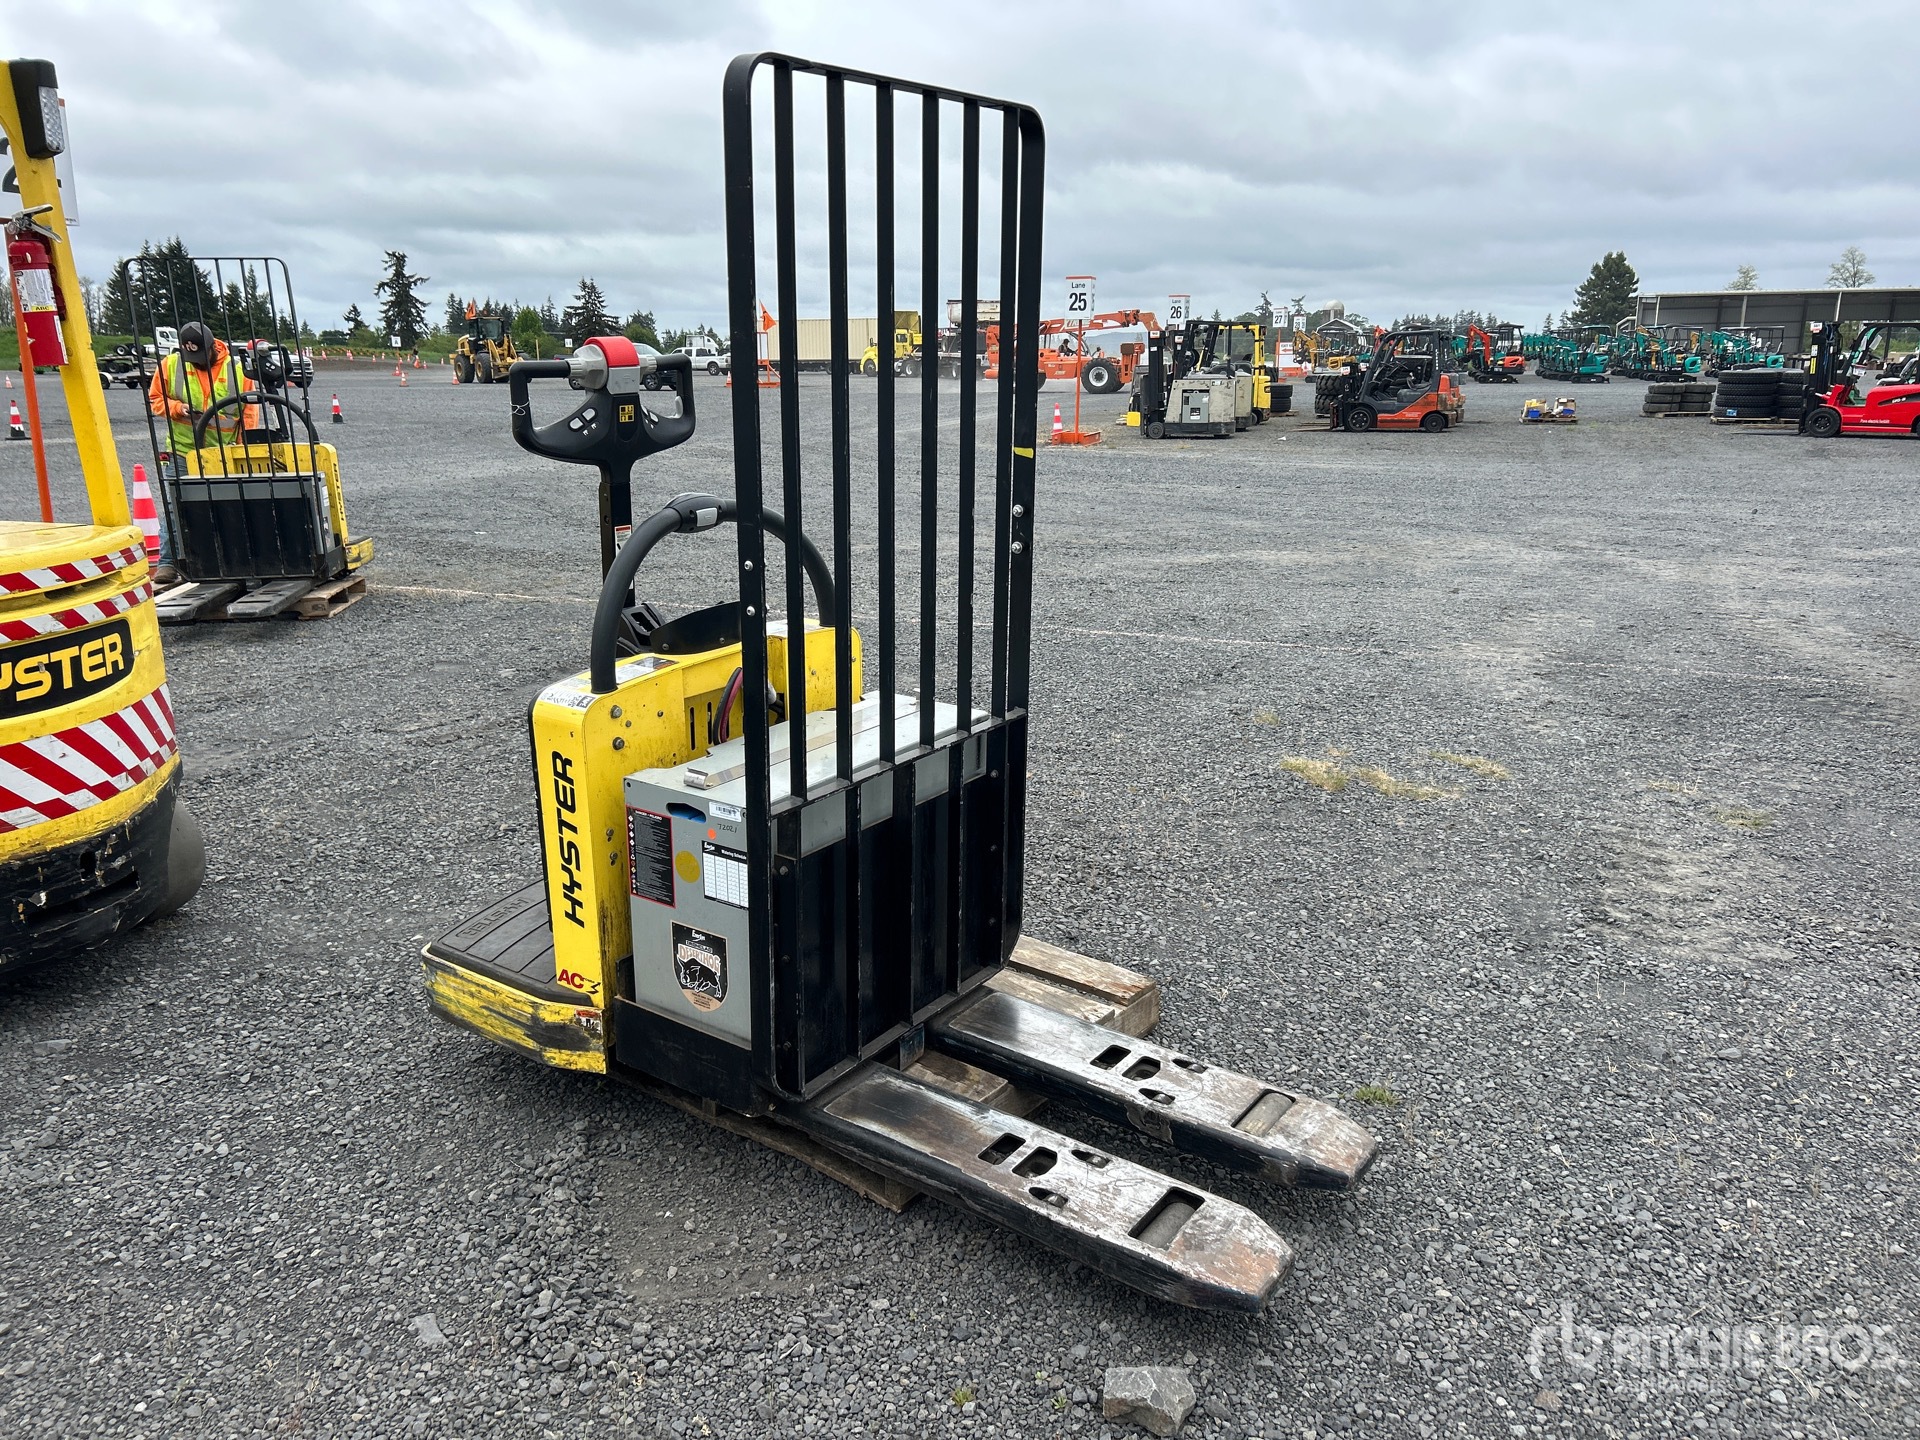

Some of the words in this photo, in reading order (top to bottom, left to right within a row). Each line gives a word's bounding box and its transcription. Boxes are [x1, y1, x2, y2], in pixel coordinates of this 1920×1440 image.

[1068, 292, 1087, 311] 25
[1170, 305, 1182, 319] 26
[1274, 315, 1283, 324] 27
[551, 750, 586, 929] HYSTER
[557, 968, 585, 989] AC
